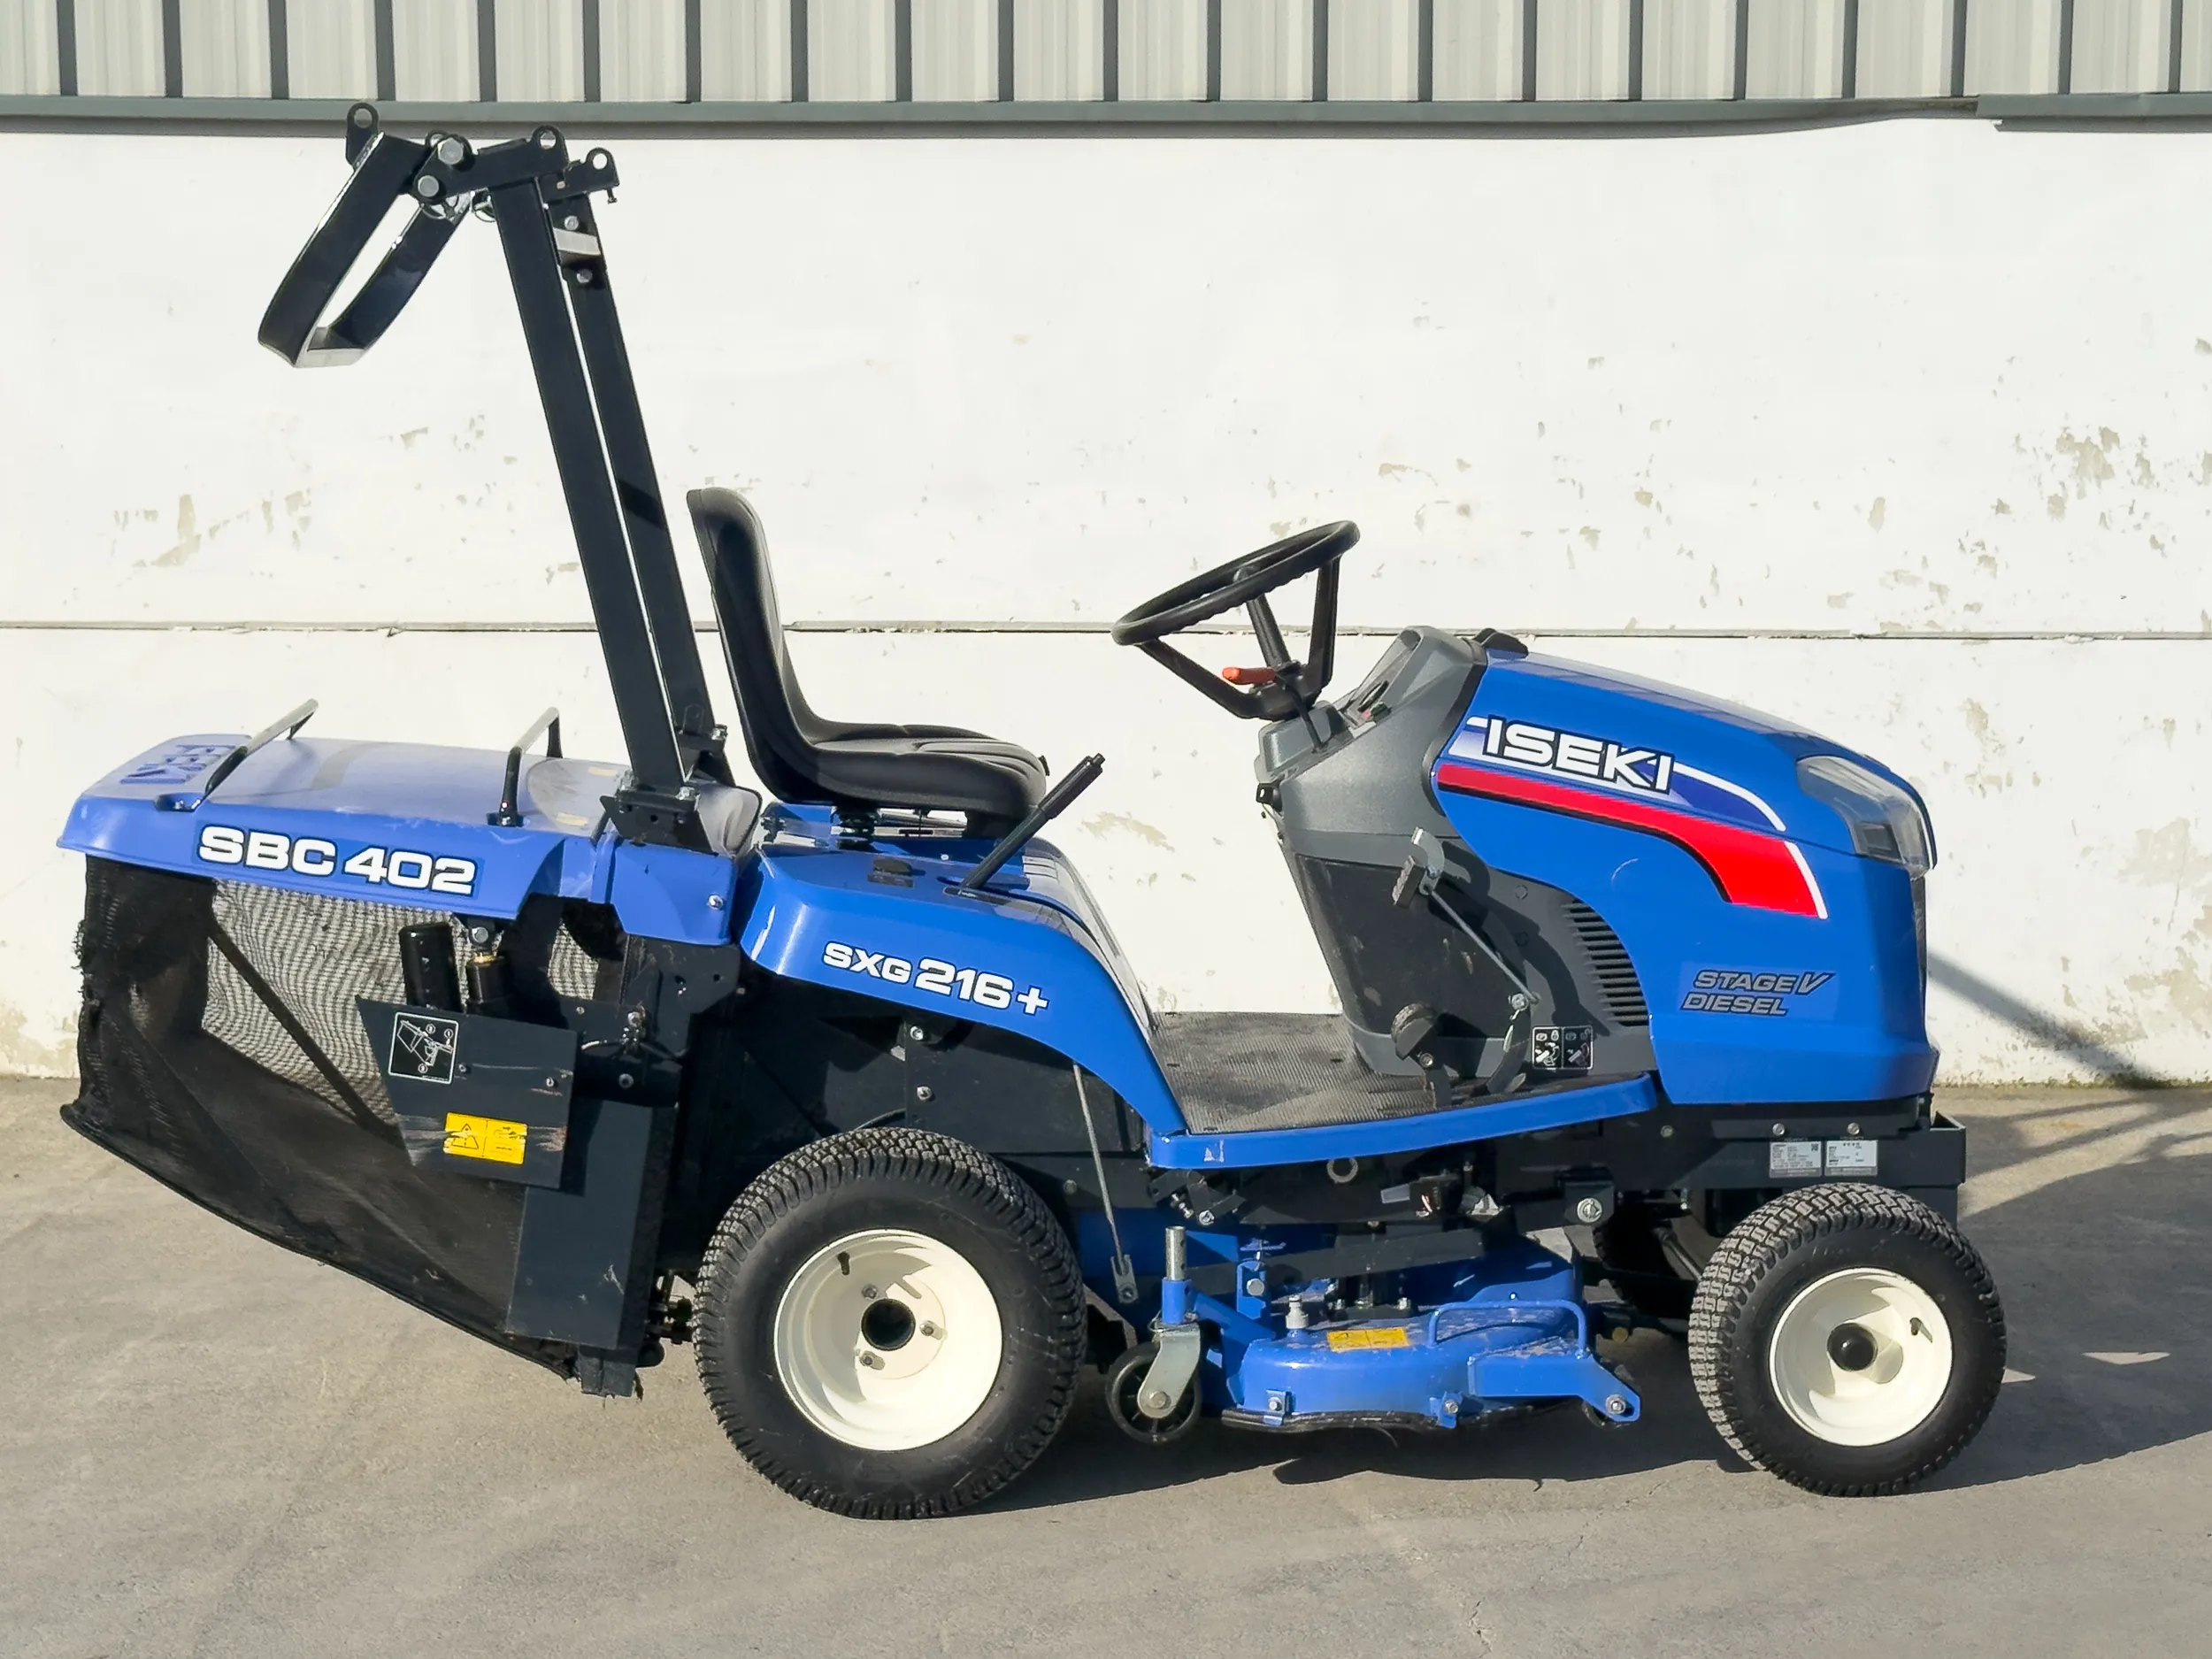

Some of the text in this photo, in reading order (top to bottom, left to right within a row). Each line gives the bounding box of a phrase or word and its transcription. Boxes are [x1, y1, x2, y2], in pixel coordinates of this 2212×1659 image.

[1484, 715, 1675, 795] ISEKI
[197, 824, 479, 897] SBC 402
[822, 941, 912, 984] SXG
[1694, 969, 1836, 995] STAGE V
[1681, 992, 1788, 1017] DIESEL
